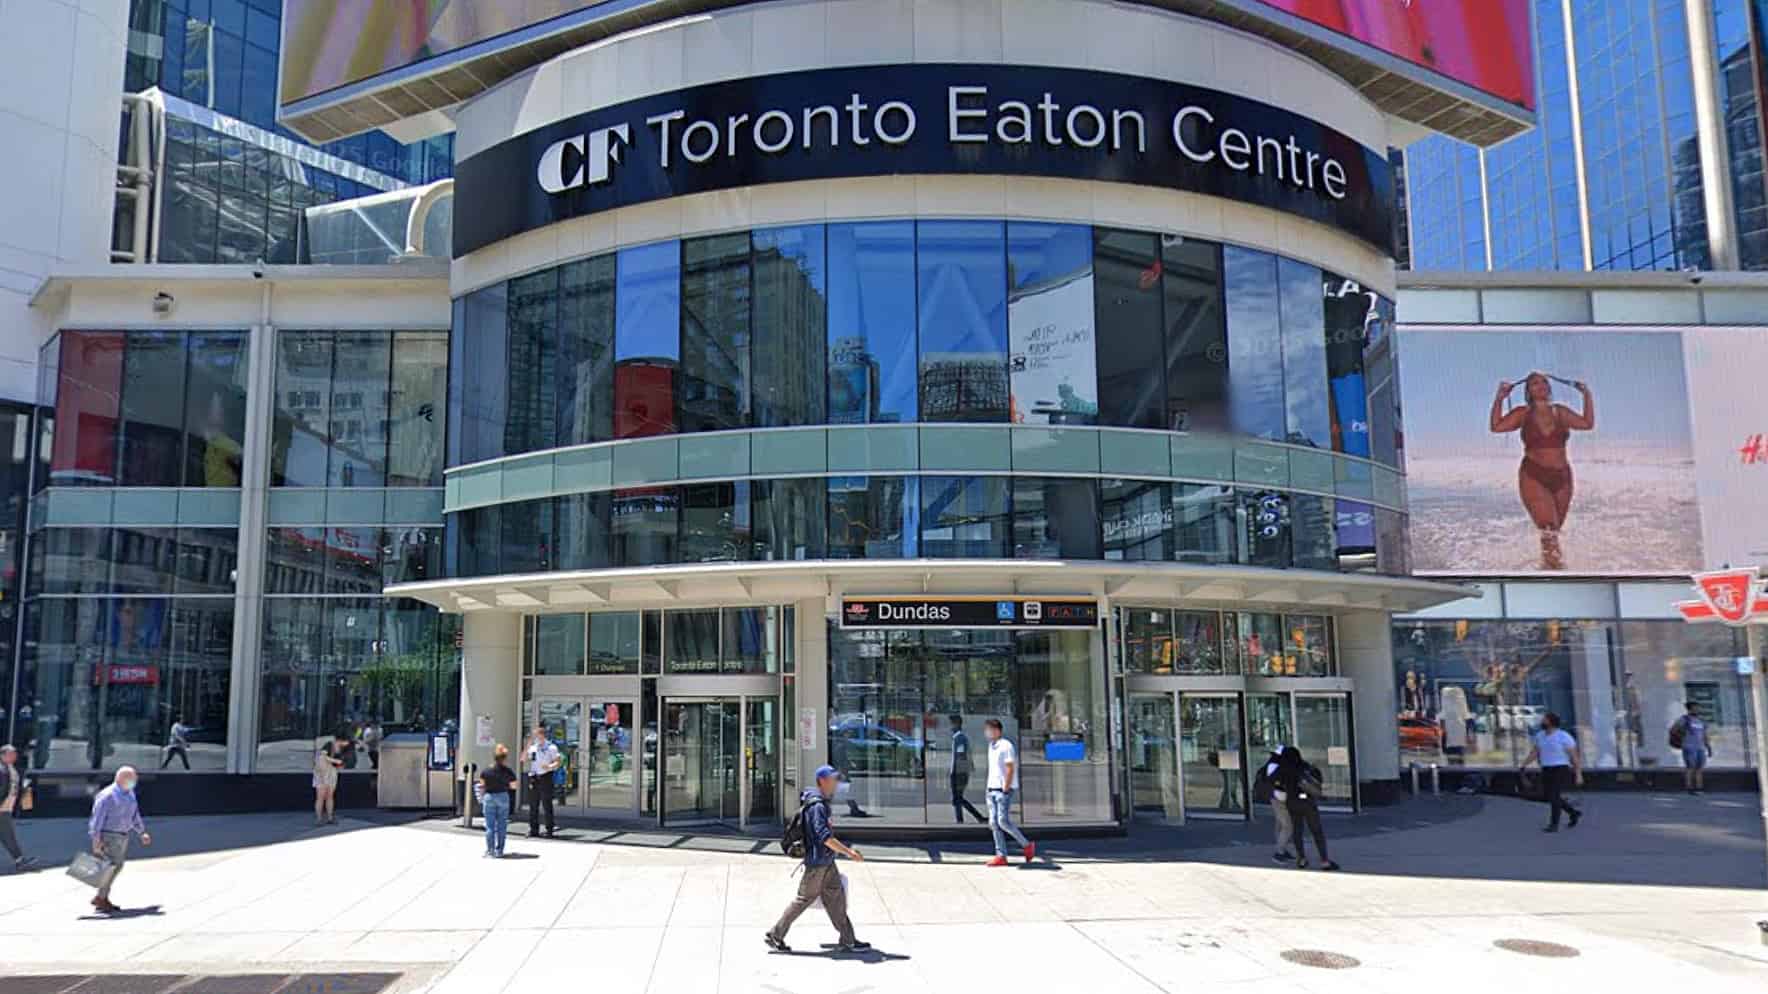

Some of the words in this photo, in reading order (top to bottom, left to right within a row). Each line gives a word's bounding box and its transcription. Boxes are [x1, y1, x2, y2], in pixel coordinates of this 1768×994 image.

[537, 122, 630, 194] CF
[646, 92, 917, 168] Toronto
[947, 86, 1146, 153] Eaton
[1172, 105, 1347, 200] Centre
[877, 602, 951, 620] Dundas
